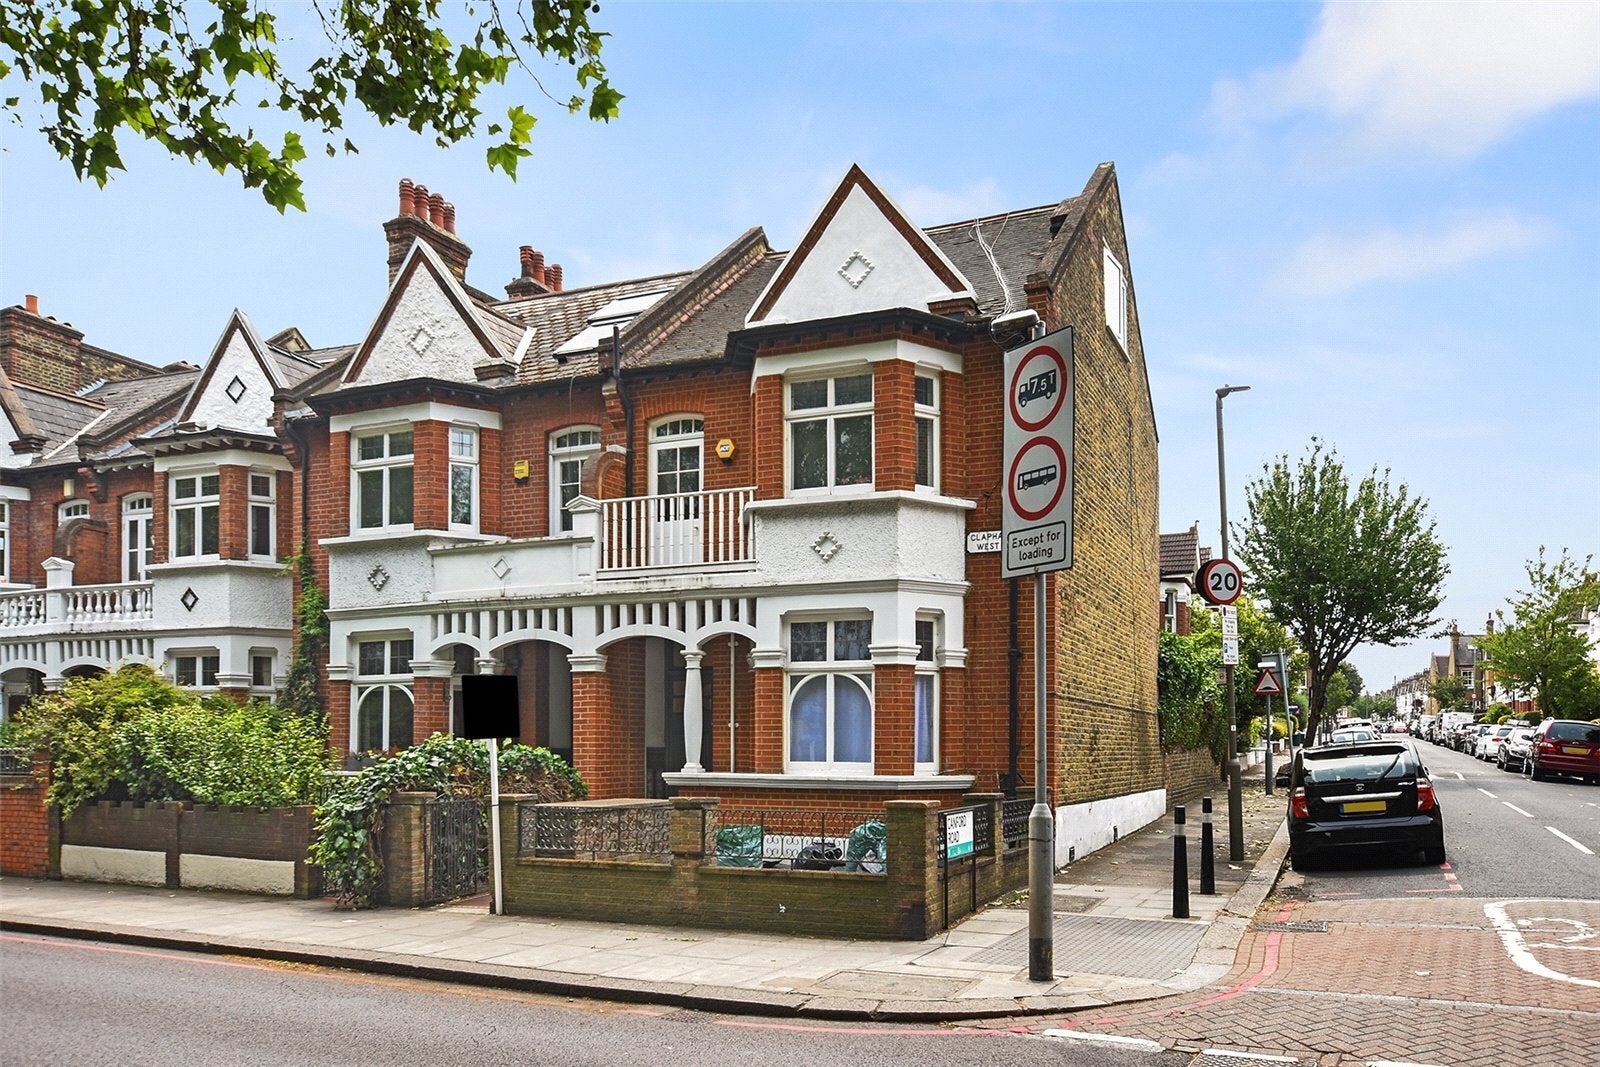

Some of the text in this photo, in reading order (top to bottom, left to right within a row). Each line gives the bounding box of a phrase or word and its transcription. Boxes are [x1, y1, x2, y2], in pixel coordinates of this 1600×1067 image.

[970, 532, 1002, 541] CLAPHA
[1012, 531, 1061, 549] Except for
[976, 542, 999, 551] WEST
[1019, 547, 1053, 561] loading
[1211, 572, 1237, 591] 20
